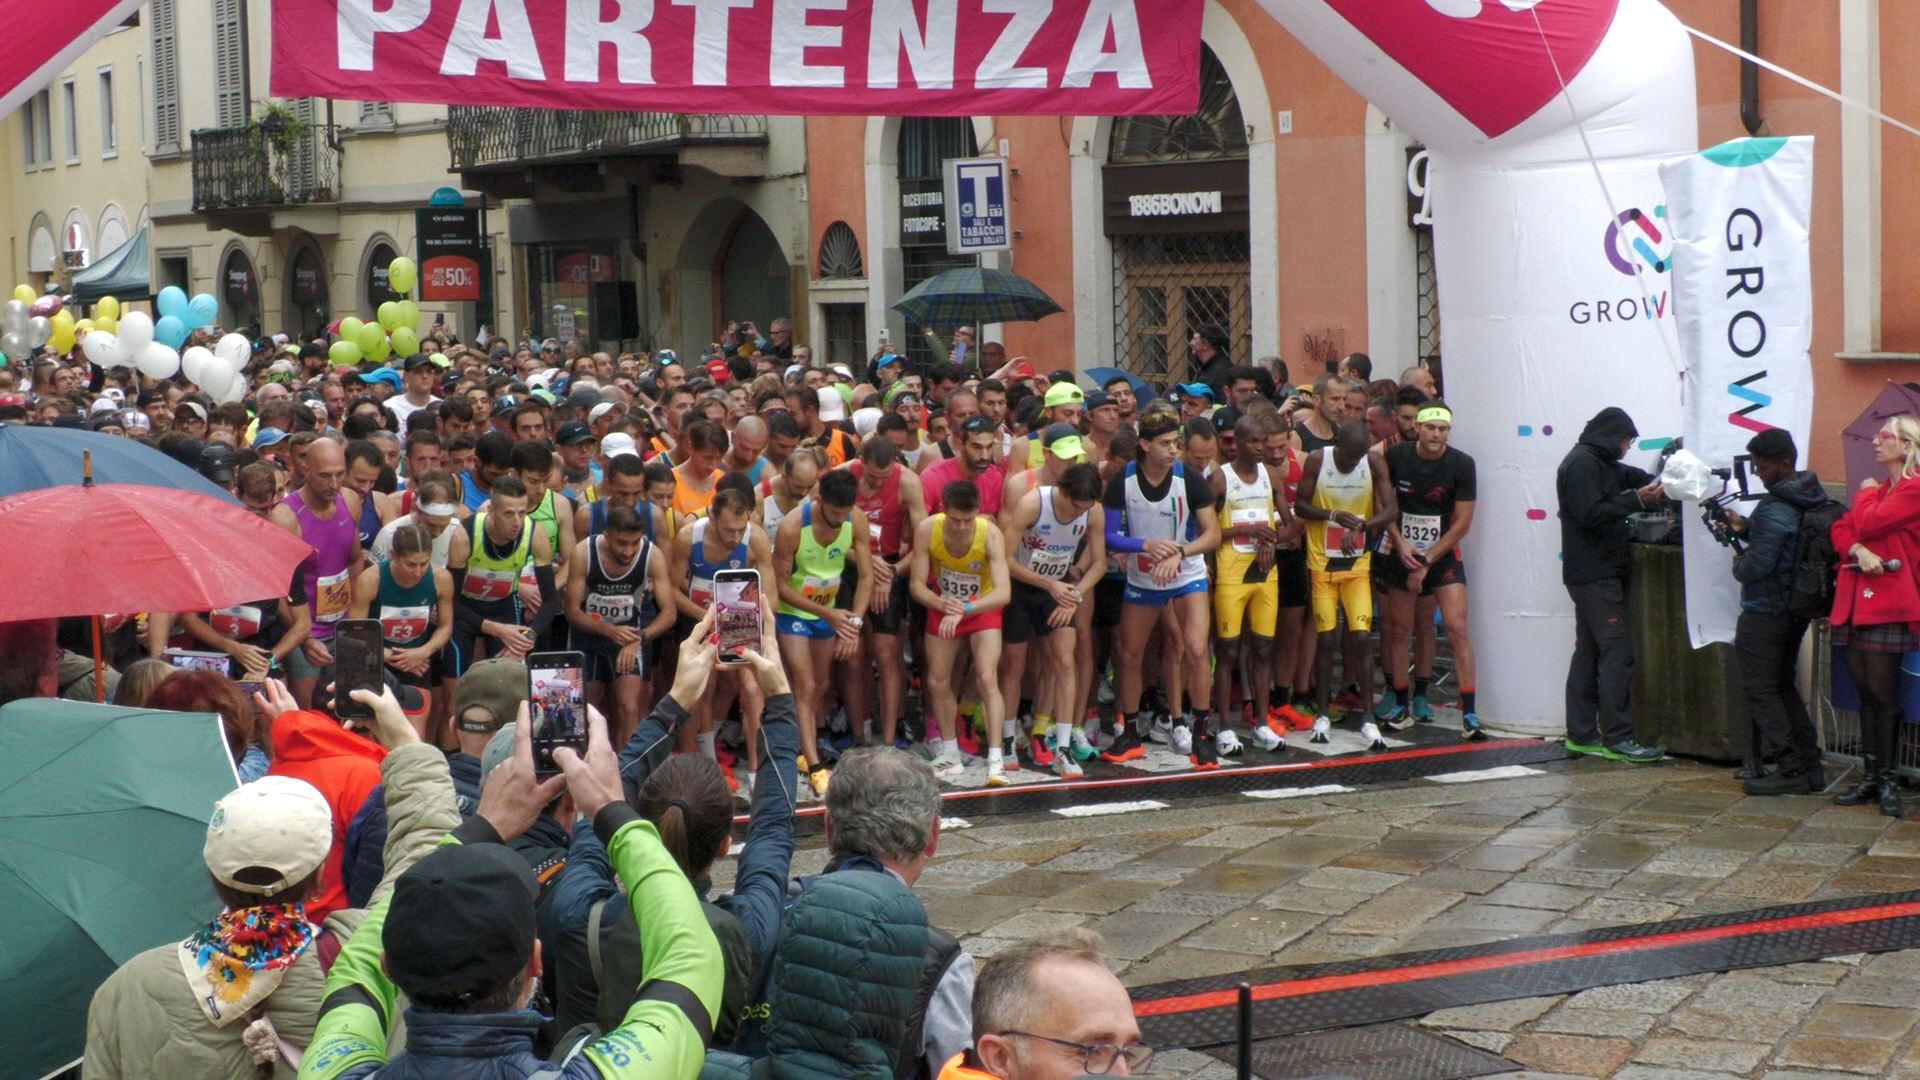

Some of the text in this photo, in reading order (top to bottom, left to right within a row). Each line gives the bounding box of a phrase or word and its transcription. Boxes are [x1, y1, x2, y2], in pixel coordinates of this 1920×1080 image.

[336, 0, 1153, 92] PARTENZA
[960, 165, 999, 218] T
[1128, 191, 1222, 216] 1886BONOMI
[903, 217, 939, 233] FOTOCOPIE
[961, 225, 1004, 238] TABACCHI
[1570, 291, 1674, 324] GROW
[1403, 524, 1439, 541] 3329
[1031, 561, 1067, 576] 3002
[482, 585, 493, 596] 7
[942, 578, 979, 596] 3359
[589, 603, 629, 618] 3001
[230, 623, 239, 636] 3
[390, 625, 413, 638] F3
